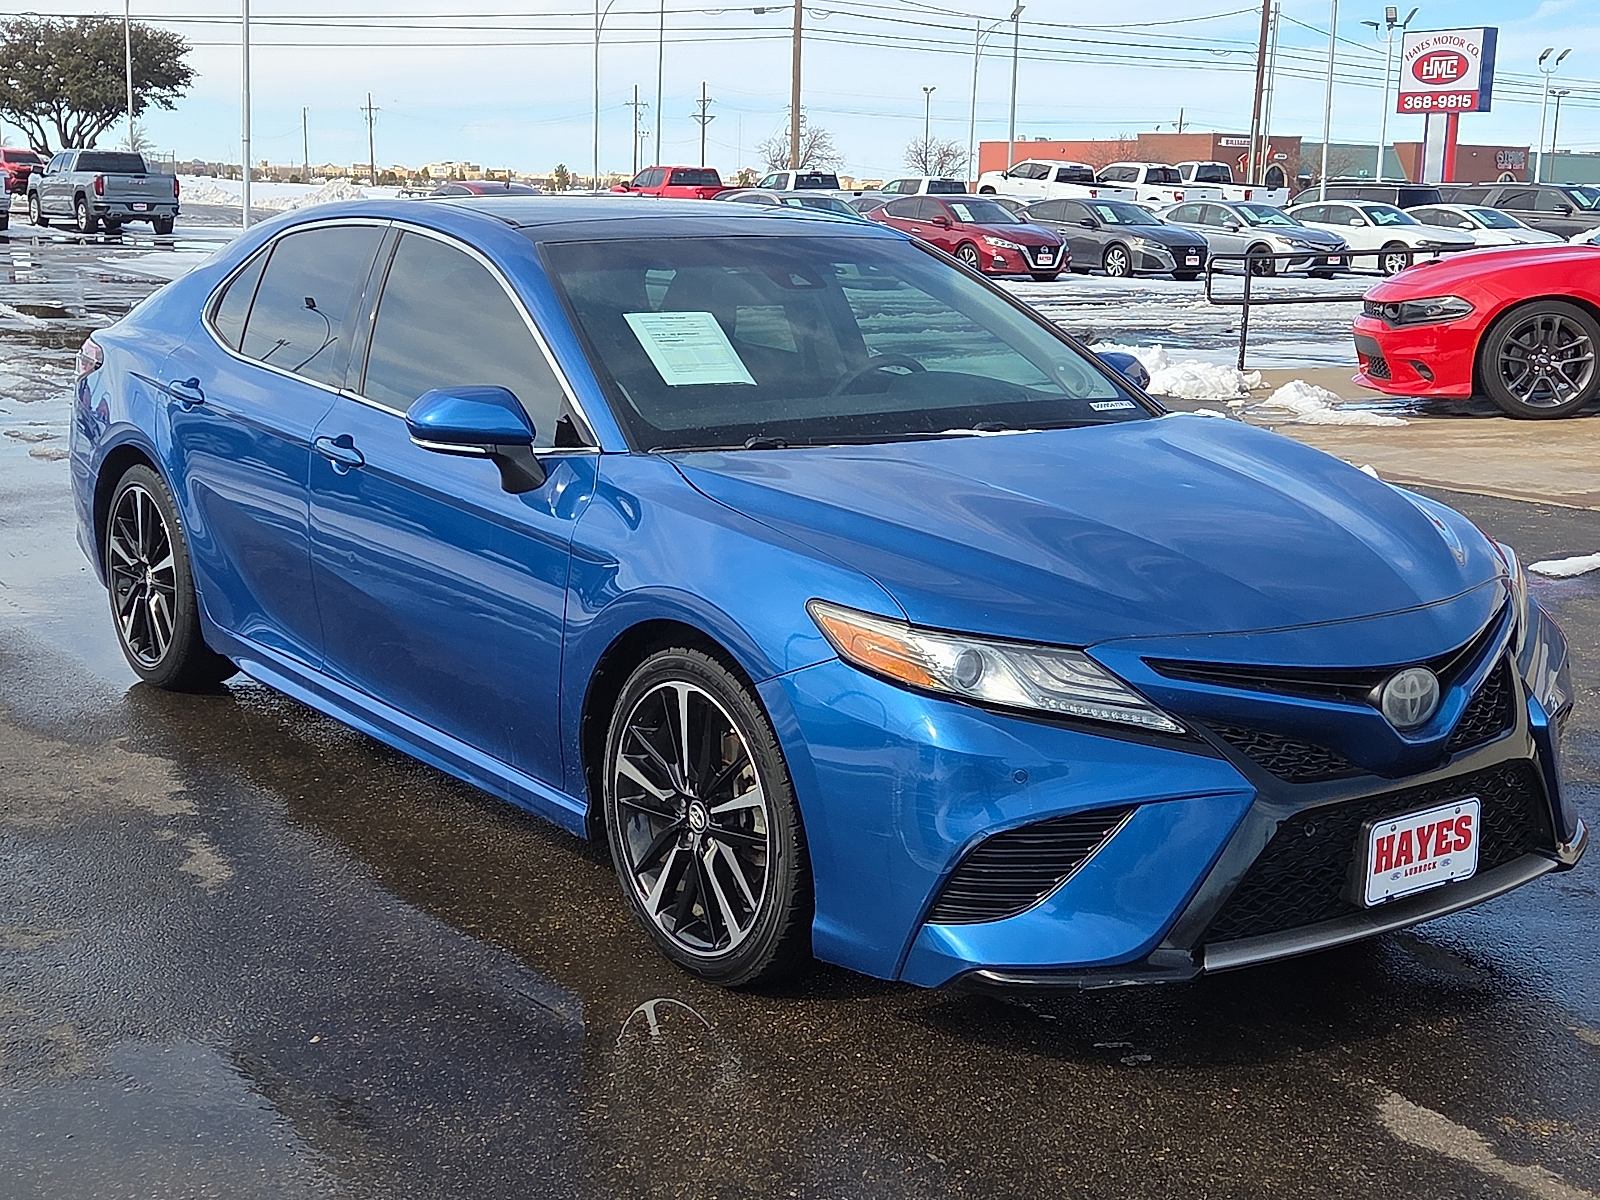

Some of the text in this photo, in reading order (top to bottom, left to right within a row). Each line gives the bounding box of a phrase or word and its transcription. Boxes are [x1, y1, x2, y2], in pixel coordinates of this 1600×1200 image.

[1405, 35, 1480, 62] HAYES MOTOR CO.
[1422, 55, 1459, 80] HMC
[1403, 94, 1472, 110] 368-9815
[1373, 815, 1472, 875] HAYES
